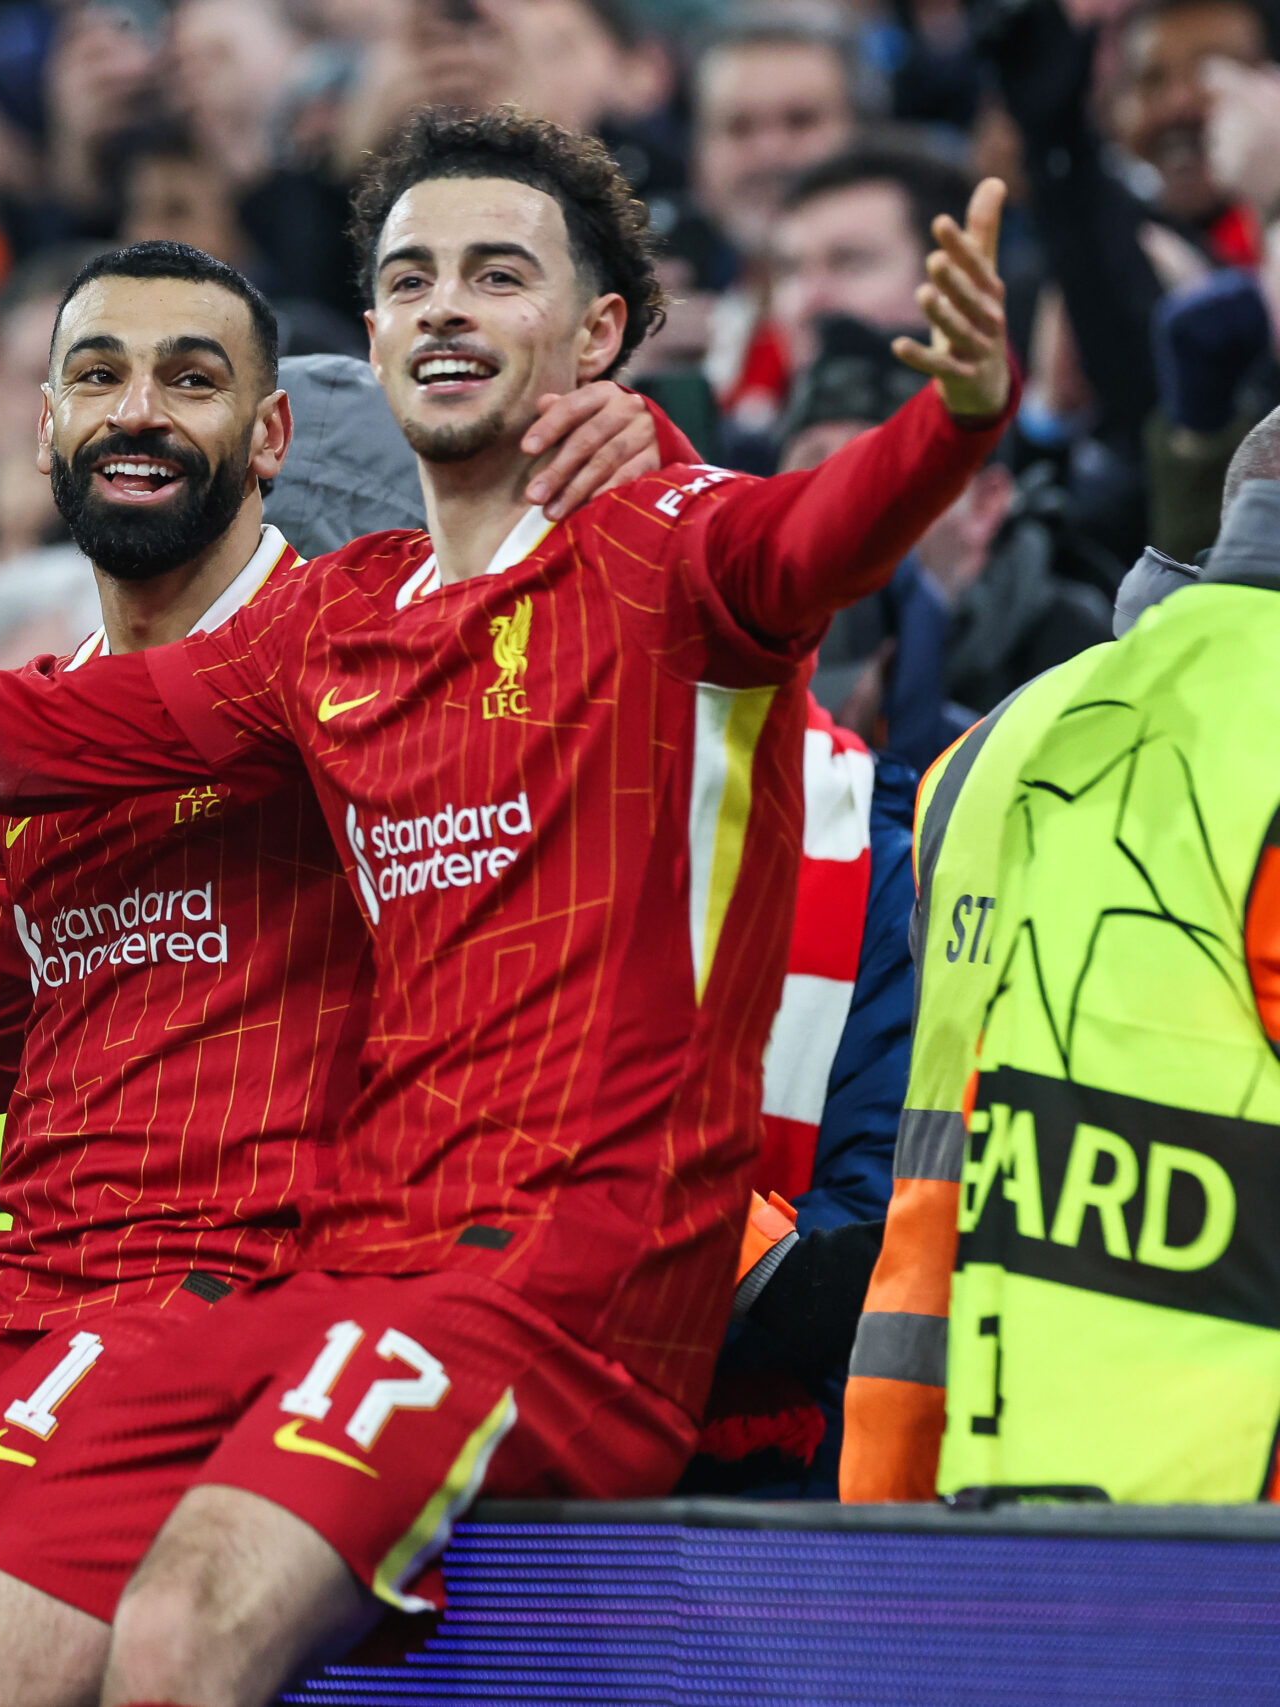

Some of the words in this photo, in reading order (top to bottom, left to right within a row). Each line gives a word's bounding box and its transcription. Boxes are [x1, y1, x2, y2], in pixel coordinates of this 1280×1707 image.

[371, 791, 532, 858] standard
[379, 848, 519, 901] chartere
[52, 881, 212, 944] standard
[946, 894, 996, 965] ST
[43, 924, 228, 988] chartered
[279, 1320, 451, 1453] 17
